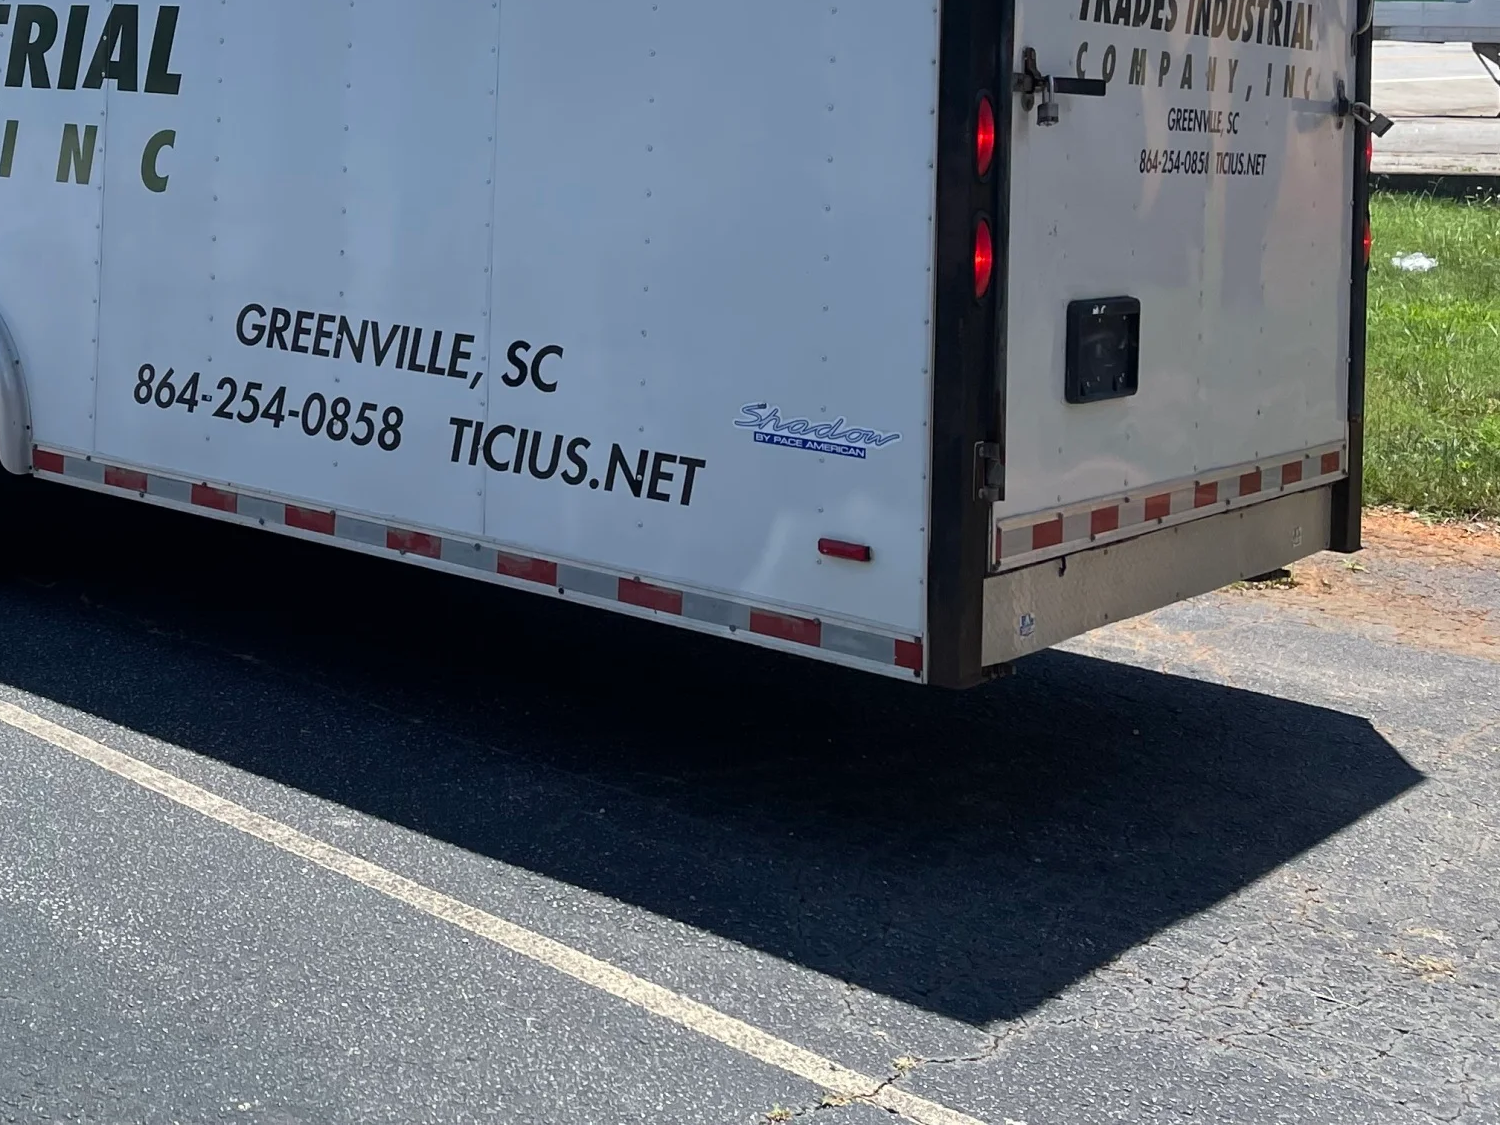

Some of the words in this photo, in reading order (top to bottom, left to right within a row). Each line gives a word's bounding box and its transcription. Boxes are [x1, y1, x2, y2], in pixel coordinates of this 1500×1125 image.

[1167, 107, 1224, 137] GREENVILLE,
[1226, 111, 1240, 135] SC
[1216, 151, 1267, 176] TICIUS.NET
[235, 303, 484, 389] GREENVILLE,
[501, 340, 563, 393] SC
[133, 363, 404, 451] 864-254-0858
[449, 417, 706, 506] TICIUS.NET
[734, 403, 900, 446] Shadow
[755, 433, 770, 442] BY
[773, 436, 803, 448] PACE
[805, 441, 865, 457] AMERICAN
